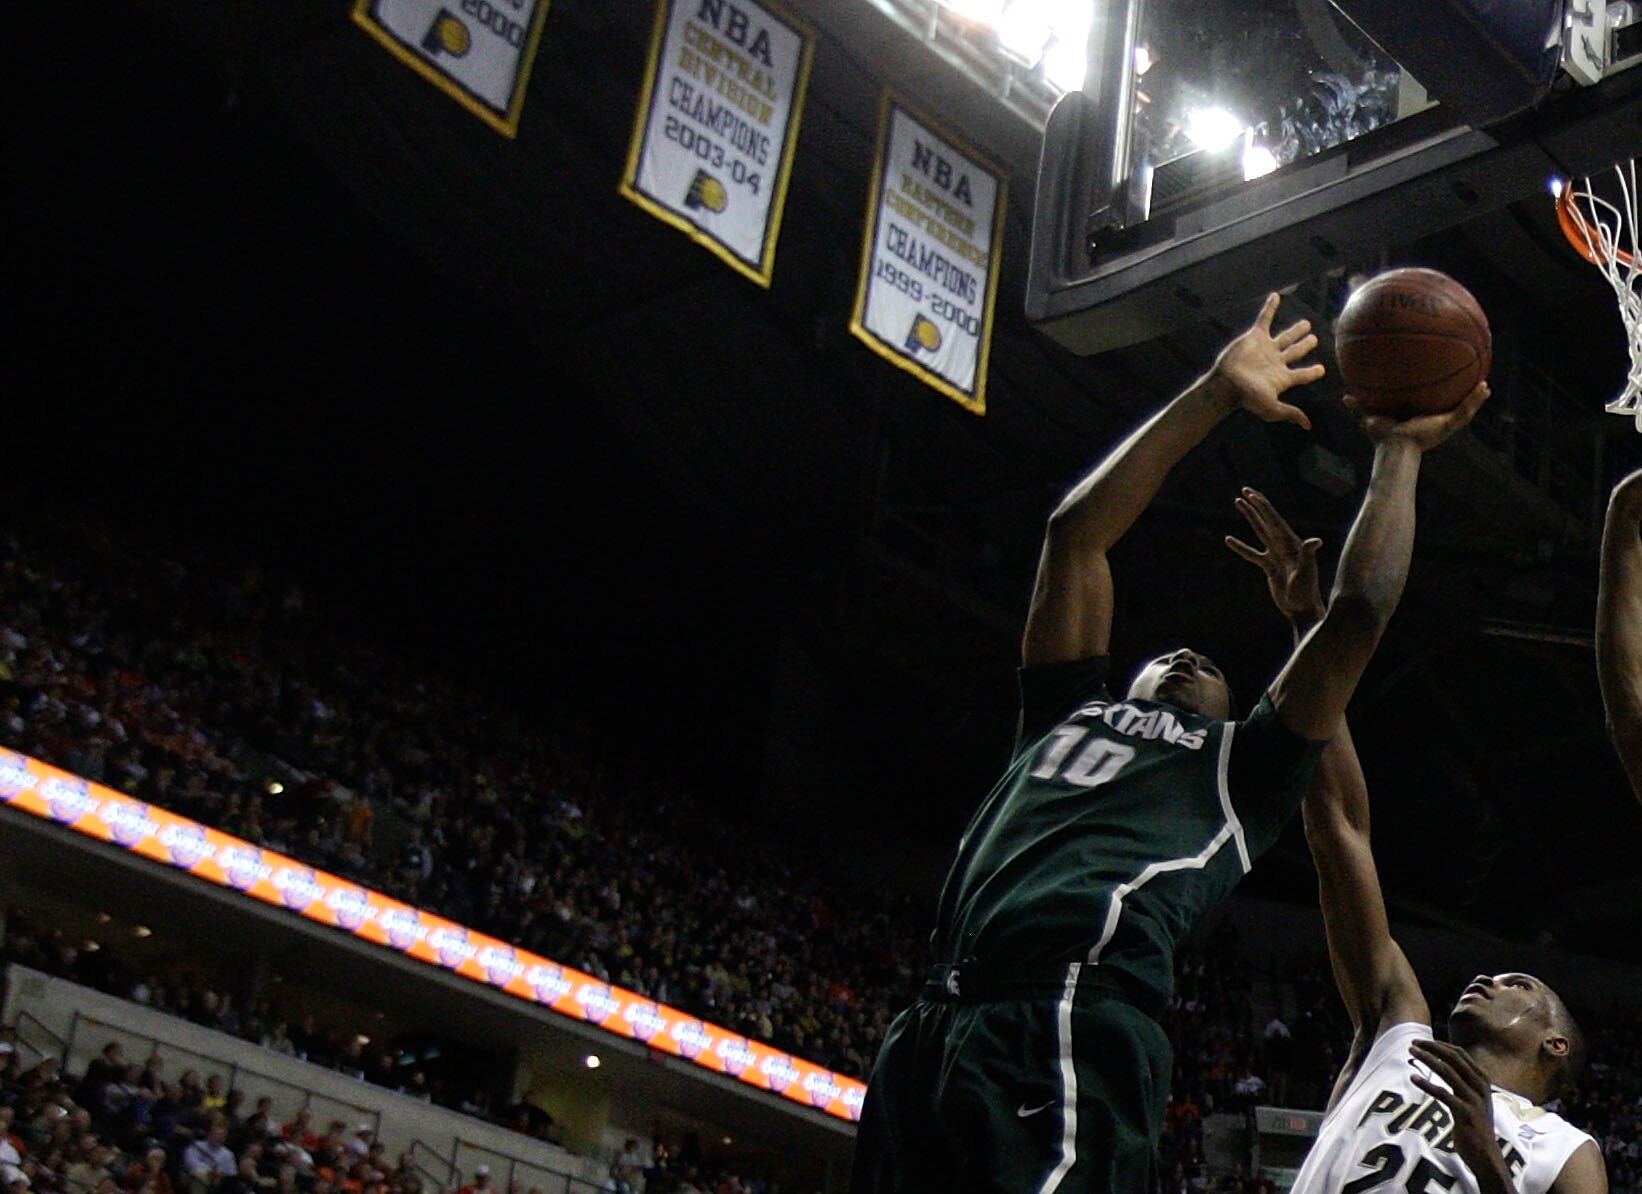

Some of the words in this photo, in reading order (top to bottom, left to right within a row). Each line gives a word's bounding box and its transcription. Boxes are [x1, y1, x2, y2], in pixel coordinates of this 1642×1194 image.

[697, 0, 773, 67] NBA
[665, 115, 761, 196] 2003-04
[668, 76, 771, 166] CHAMPIONS
[910, 138, 973, 207] NBA
[876, 258, 981, 336] 1999-2000
[885, 223, 977, 305] CHAMPIONS
[1031, 724, 1136, 788] 10
